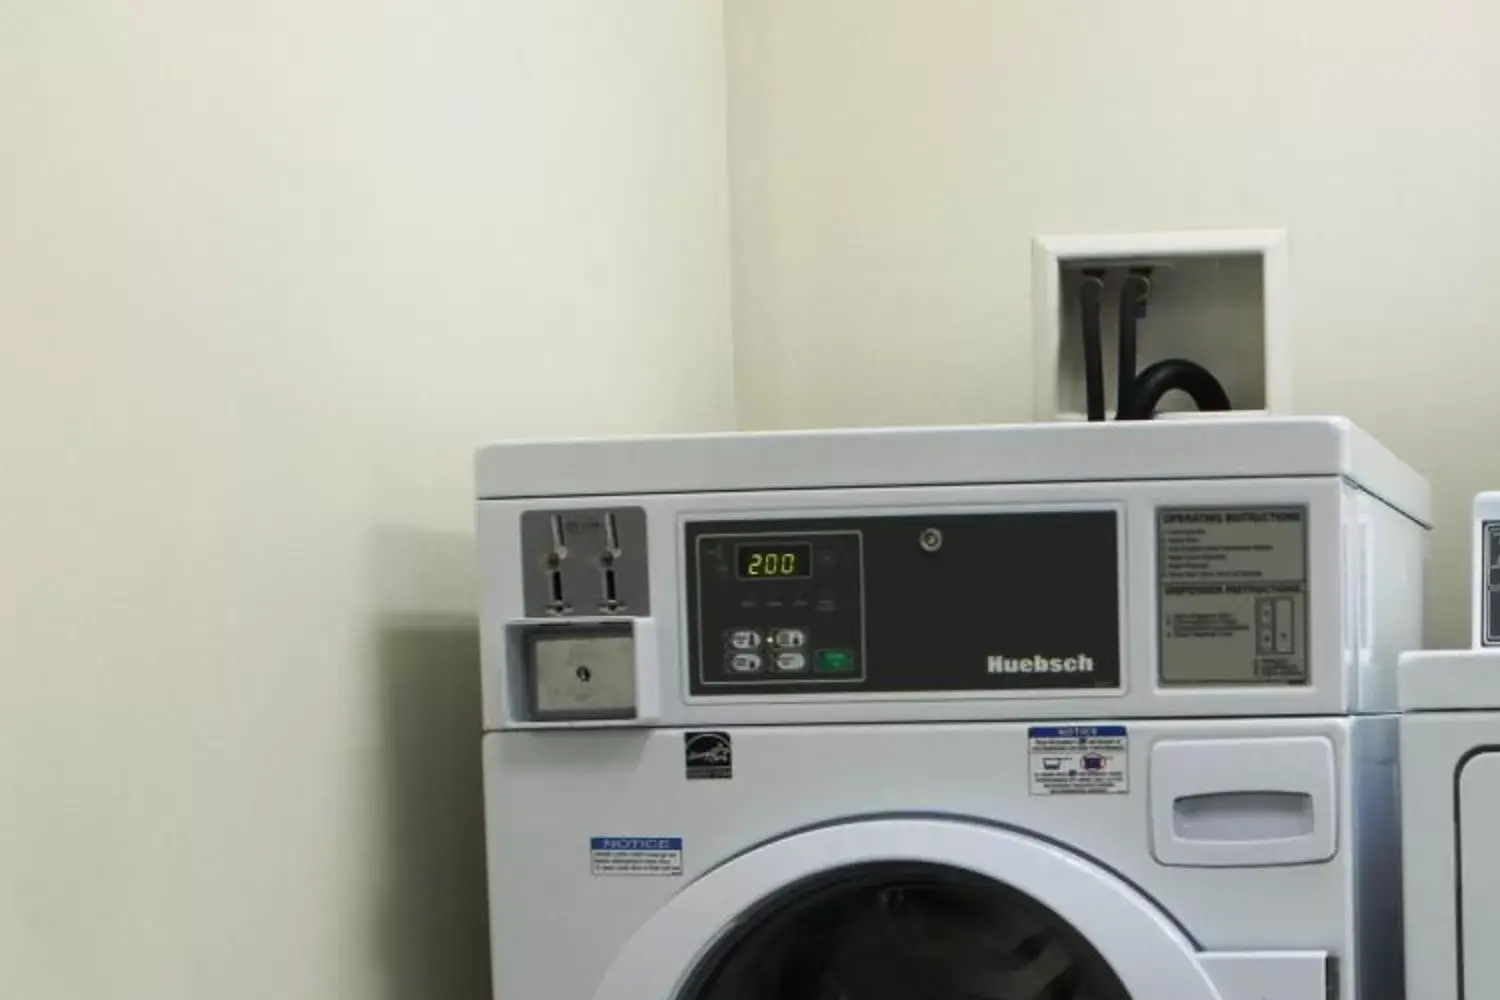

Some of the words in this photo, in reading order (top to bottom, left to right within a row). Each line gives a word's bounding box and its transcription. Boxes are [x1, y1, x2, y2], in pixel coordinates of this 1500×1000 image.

[748, 553, 796, 575] 200
[987, 653, 1094, 673] Huebsch
[603, 839, 669, 849] NOTICE
